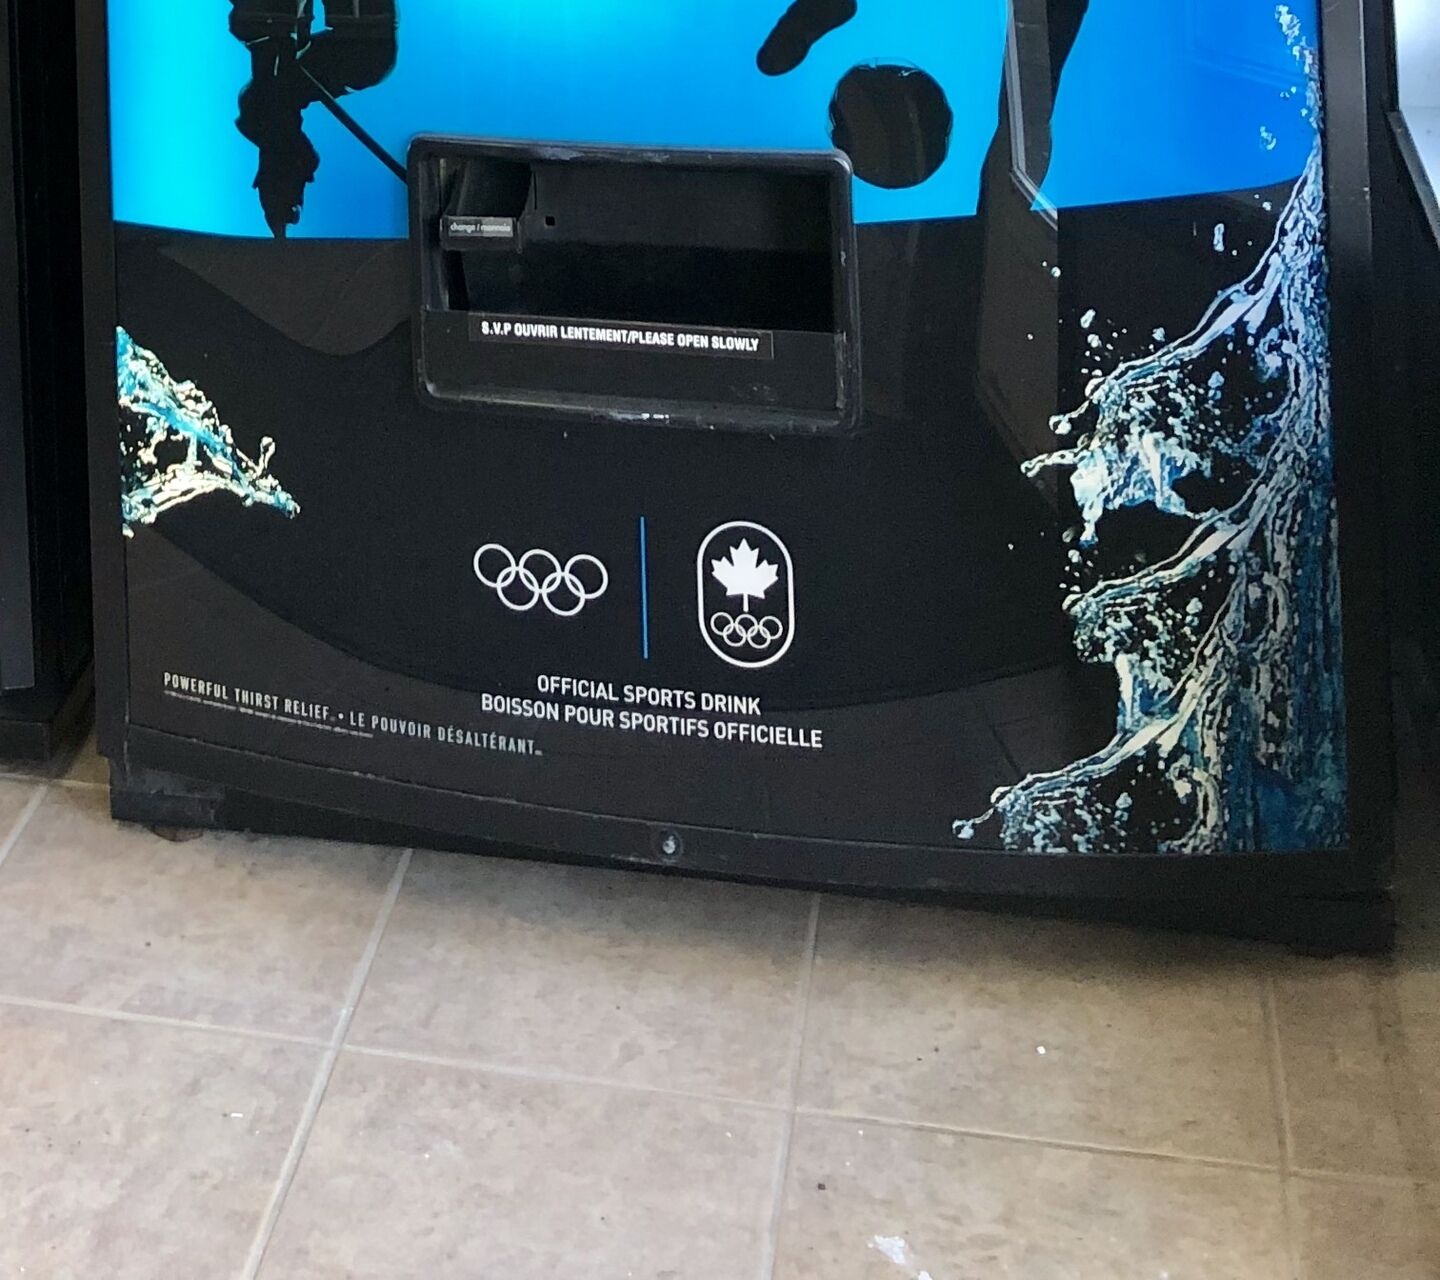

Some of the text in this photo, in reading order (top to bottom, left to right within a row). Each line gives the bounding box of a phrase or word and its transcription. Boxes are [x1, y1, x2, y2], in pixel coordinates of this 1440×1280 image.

[513, 322, 558, 339] OUVRIR
[560, 325, 675, 347] LENTEMENT/PLEASE
[677, 332, 709, 349] OPEN
[711, 334, 759, 352] SLOWLY
[163, 671, 229, 700] POWERFUL
[234, 687, 279, 711] THIRST
[284, 697, 330, 722] RELIEF
[349, 711, 366, 728] LE
[371, 715, 432, 740] POUVOIR
[437, 721, 535, 756] DÉSALTÉRANT
[537, 673, 761, 716] OFFICIAL SPORTS DRINK
[481, 692, 824, 749] BOISSON POUR SPORTIFS OFFICIELLE
